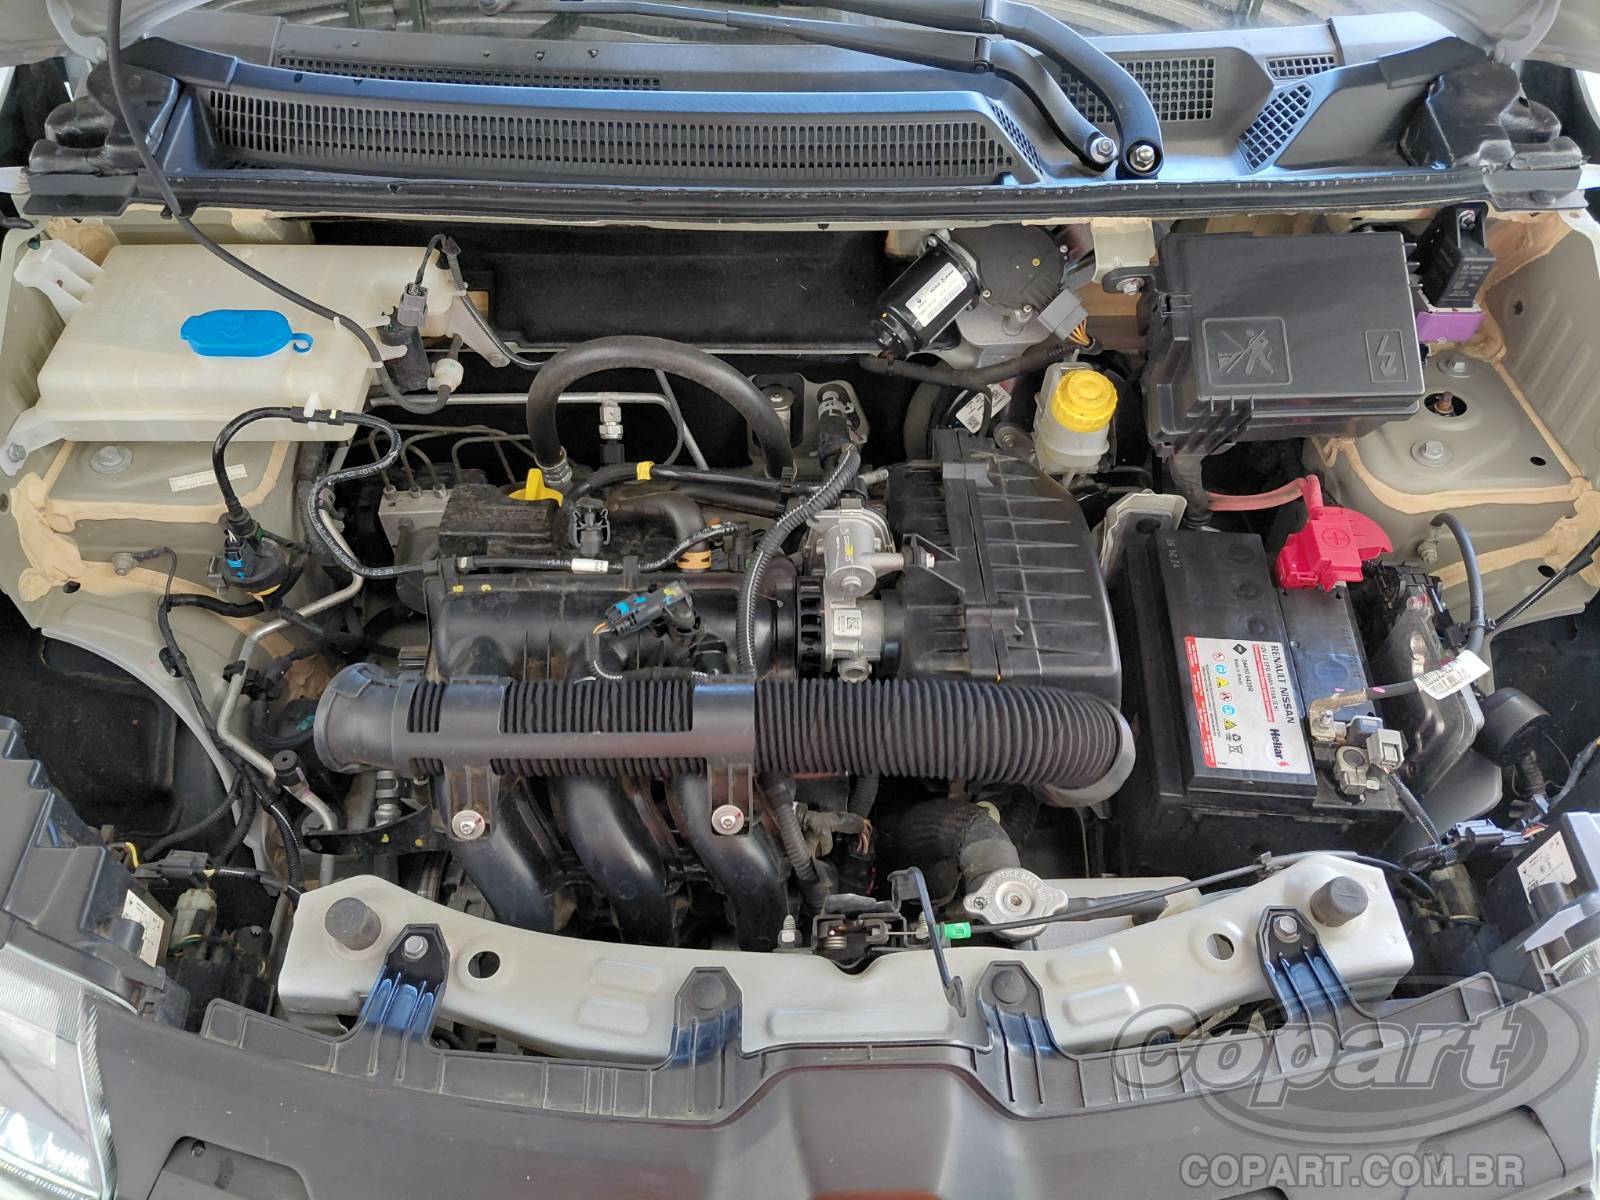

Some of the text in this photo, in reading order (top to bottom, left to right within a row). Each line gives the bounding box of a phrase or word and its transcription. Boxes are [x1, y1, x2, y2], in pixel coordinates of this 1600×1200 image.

[1271, 645, 1295, 724] RENAULT NISSAN
[1270, 728, 1283, 759] Heliar
